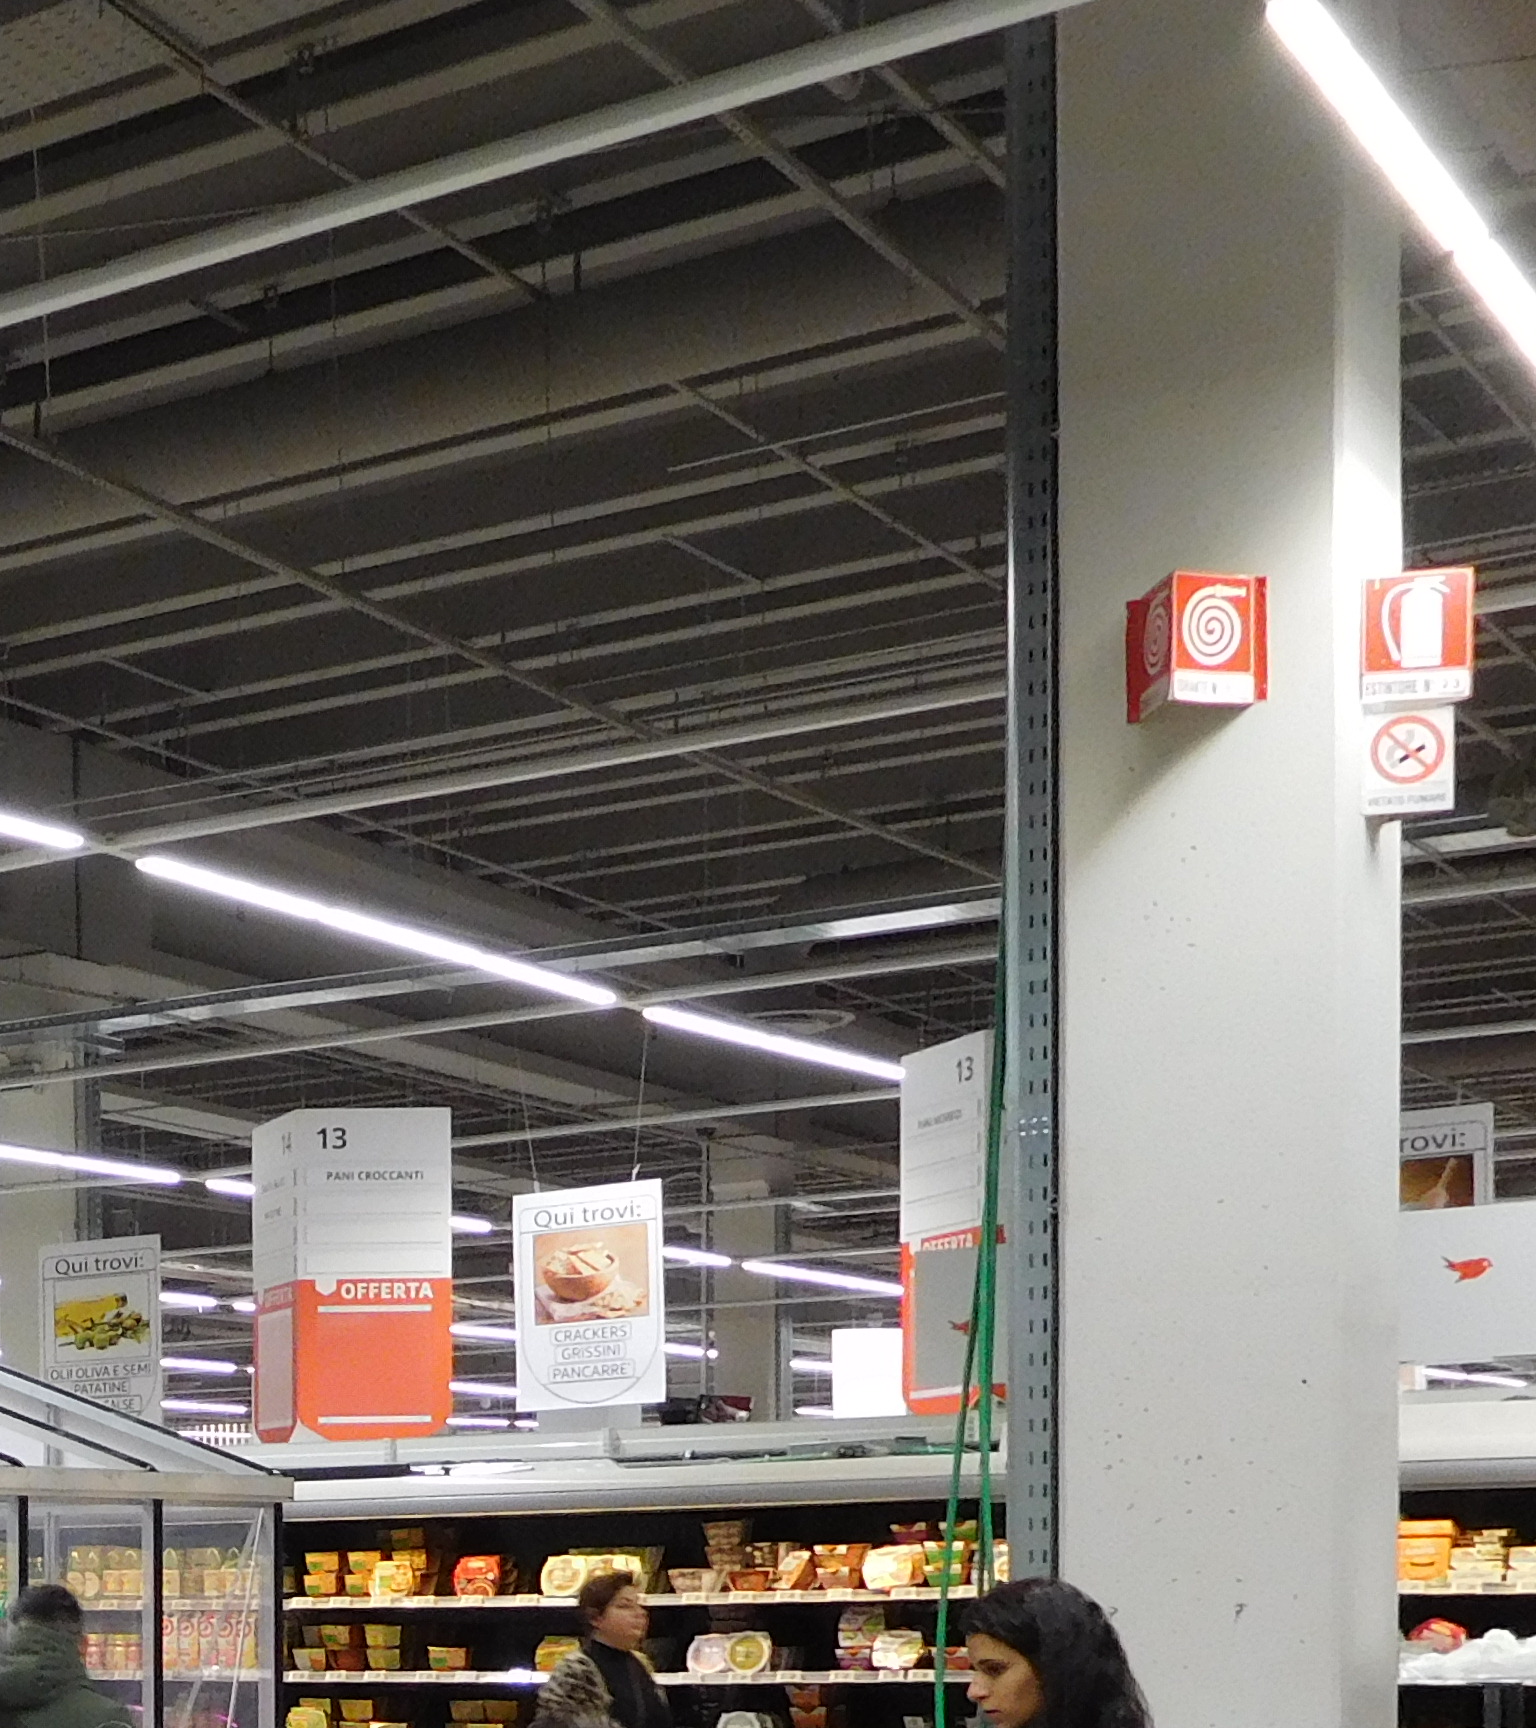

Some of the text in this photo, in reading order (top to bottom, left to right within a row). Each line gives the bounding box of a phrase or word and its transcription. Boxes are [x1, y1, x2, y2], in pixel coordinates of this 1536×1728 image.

[956, 1056, 974, 1083] 13
[315, 1127, 348, 1151] 13
[1400, 1127, 1467, 1154] rovi:
[326, 1169, 424, 1181] PANI CROCCANTI
[534, 1200, 643, 1231] Qui trovi:
[54, 1251, 146, 1276] Qui trovi:
[341, 1280, 435, 1300] OFFERTA
[553, 1325, 628, 1344] CRACKERS
[560, 1344, 622, 1361] GRISSINI
[75, 1367, 111, 1380] OLIVA
[113, 1365, 120, 1376] E
[74, 1381, 128, 1394] PATATINE
